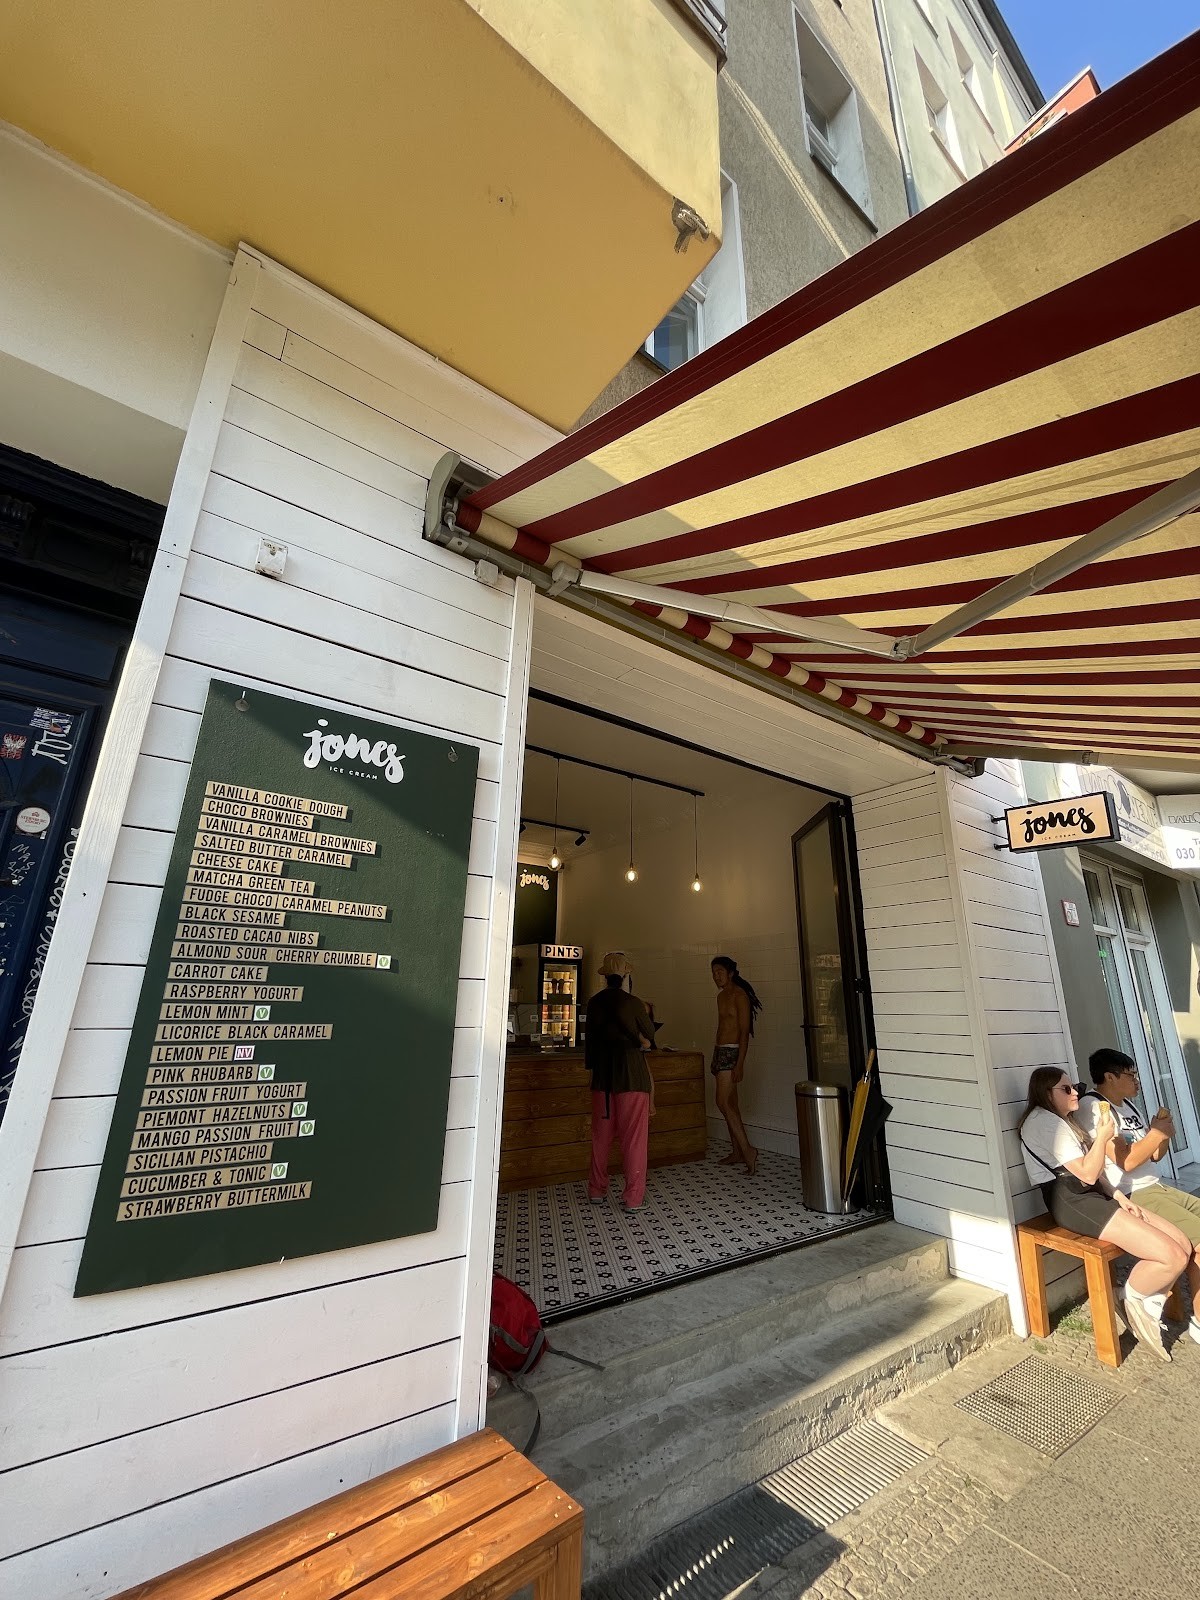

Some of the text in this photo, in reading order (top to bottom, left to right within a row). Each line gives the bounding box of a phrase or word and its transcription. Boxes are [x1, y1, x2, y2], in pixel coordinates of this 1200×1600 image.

[303, 719, 406, 783] jones
[330, 766, 378, 780] ICE CREAM
[212, 783, 343, 817] VANILLA COOKIE DOUGH
[208, 800, 309, 826] CHOCO BROWNIES
[206, 817, 373, 852] VANILLA CARAMEL BROWNIES
[1020, 808, 1096, 843] jones
[200, 834, 347, 866] SALTED BUTTER CARAMEL
[1176, 848, 1196, 860] 030
[197, 852, 277, 873] CHEESE CAKE
[194, 870, 310, 894] MATCHA GREEN TEA
[520, 869, 550, 890] jones
[190, 888, 384, 918] FUDGE CHOCO CARAMEL PEANUTS
[185, 906, 280, 924] BLACK SESAME
[182, 925, 314, 944] ROASTED CACAO NIBS
[176, 944, 230, 959] ALMOND
[236, 946, 267, 960] SOUR
[276, 949, 320, 963] CHERRY
[324, 952, 372, 966] CRUMBLE
[545, 946, 580, 958] PINTS
[174, 964, 263, 980] CARROT CAKE
[170, 984, 298, 1000] RASPBERRY YOGURT
[165, 1005, 212, 1019] LEMON
[216, 1006, 249, 1019] MINT
[162, 1026, 328, 1040] LICORICE BLACK CARAMEL
[156, 1046, 252, 1062] LEMON PIE NV
[152, 1067, 186, 1084] PINK
[190, 1066, 254, 1081] RHUBARB
[148, 1084, 303, 1105] PASSION FRUIT YOGURT
[142, 1109, 206, 1128] PIEMONT
[212, 1104, 286, 1123] HAZELNUTS
[138, 1130, 190, 1149] MANGO
[196, 1126, 252, 1144] PASSION
[258, 1122, 294, 1138] FRUIT
[134, 1144, 268, 1170] SICILIAN PISTACHIO
[128, 1172, 208, 1195] CUCUMBER
[212, 1171, 222, 1186] &
[230, 1166, 266, 1184] TONIC
[124, 1184, 307, 1219] STRAWBERRY BUTTERMILK
